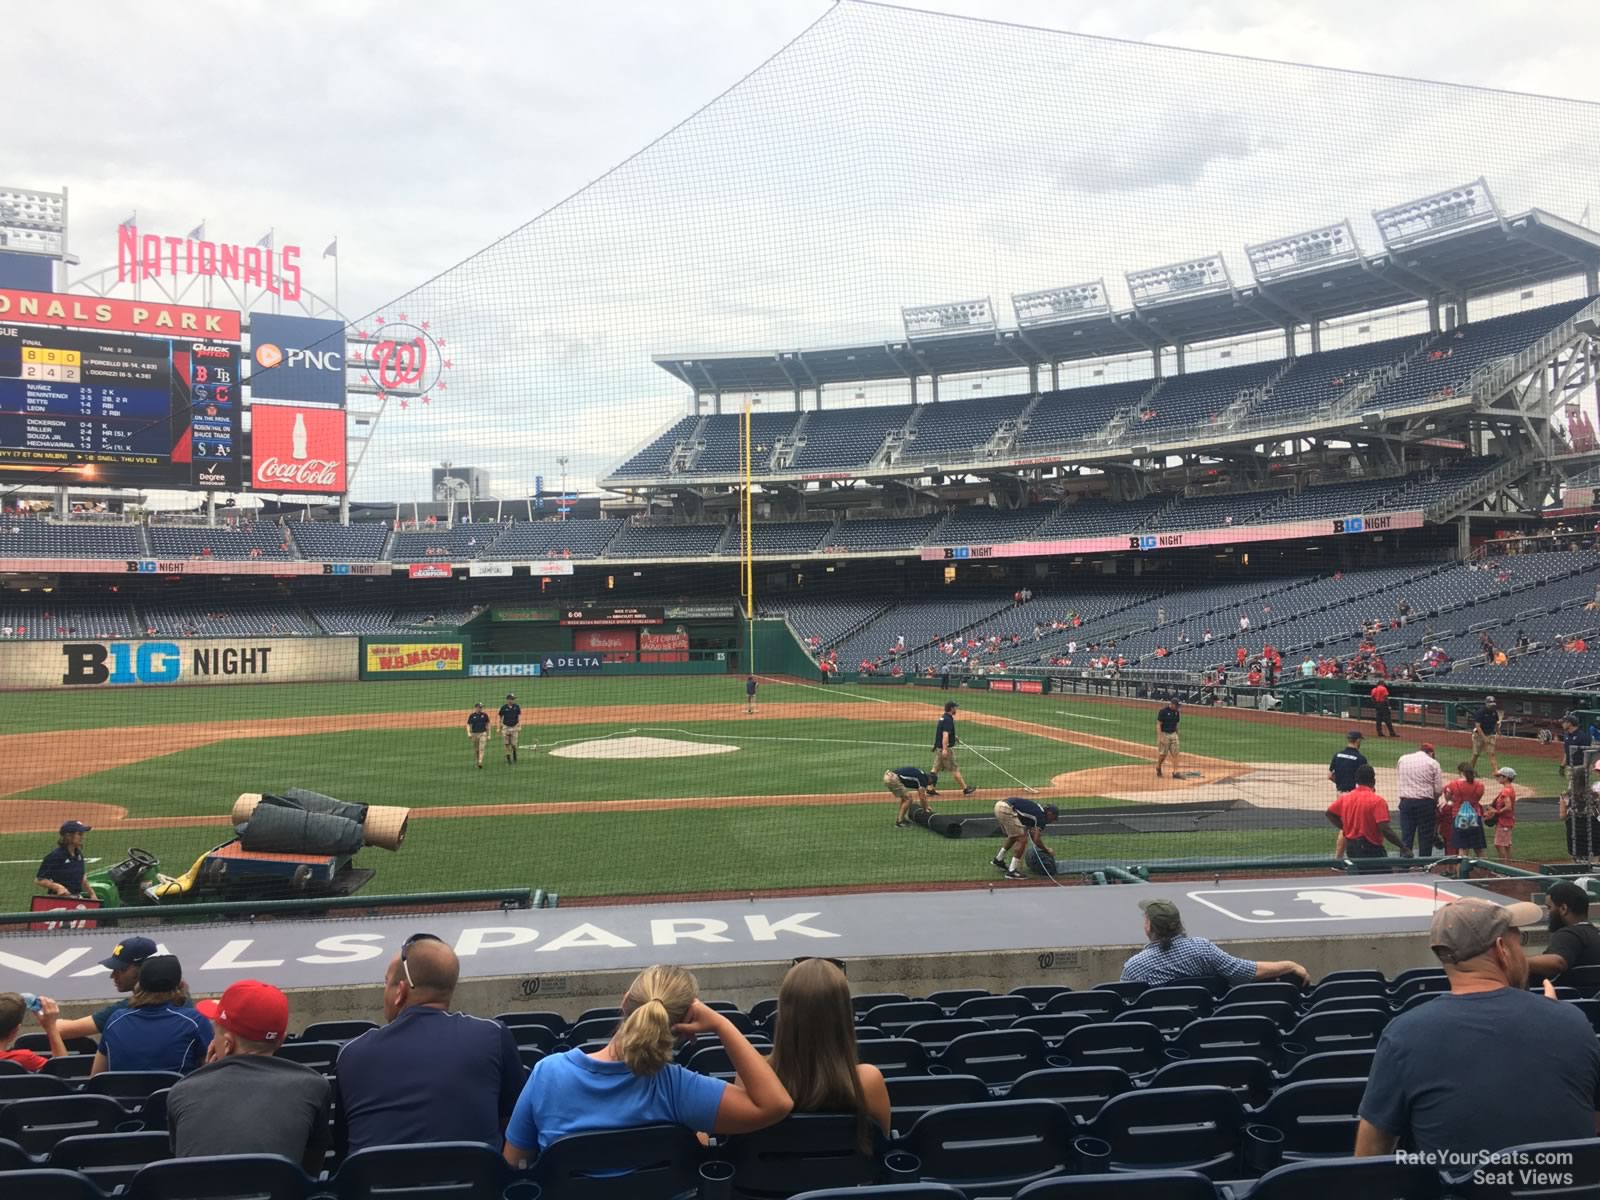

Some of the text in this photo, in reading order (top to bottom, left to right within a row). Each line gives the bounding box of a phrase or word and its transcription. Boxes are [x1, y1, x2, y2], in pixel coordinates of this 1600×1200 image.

[118, 224, 301, 301] NATIONALS
[133, 308, 222, 332] PARK
[193, 343, 230, 353] QUICK
[28, 351, 74, 362] 8 9 0
[197, 350, 230, 358] PITCH
[285, 348, 341, 371] PNC
[27, 367, 74, 378] 2 4 2
[27, 391, 68, 399] BENINTENDI
[216, 386, 229, 402] C
[27, 419, 66, 427] DICKERSON
[27, 440, 75, 448] HECHAVARRIA
[200, 473, 225, 481] Degree
[1364, 516, 1391, 530] NIGHT
[1159, 535, 1183, 546] NIGHT
[971, 546, 992, 557] NIGHT
[159, 562, 184, 573] NIGHT
[351, 564, 374, 575] NIGHT
[193, 647, 271, 675] NIGHT
[558, 657, 600, 667] DELTA
[489, 664, 536, 676] KOCH
[454, 911, 842, 956] PARK
